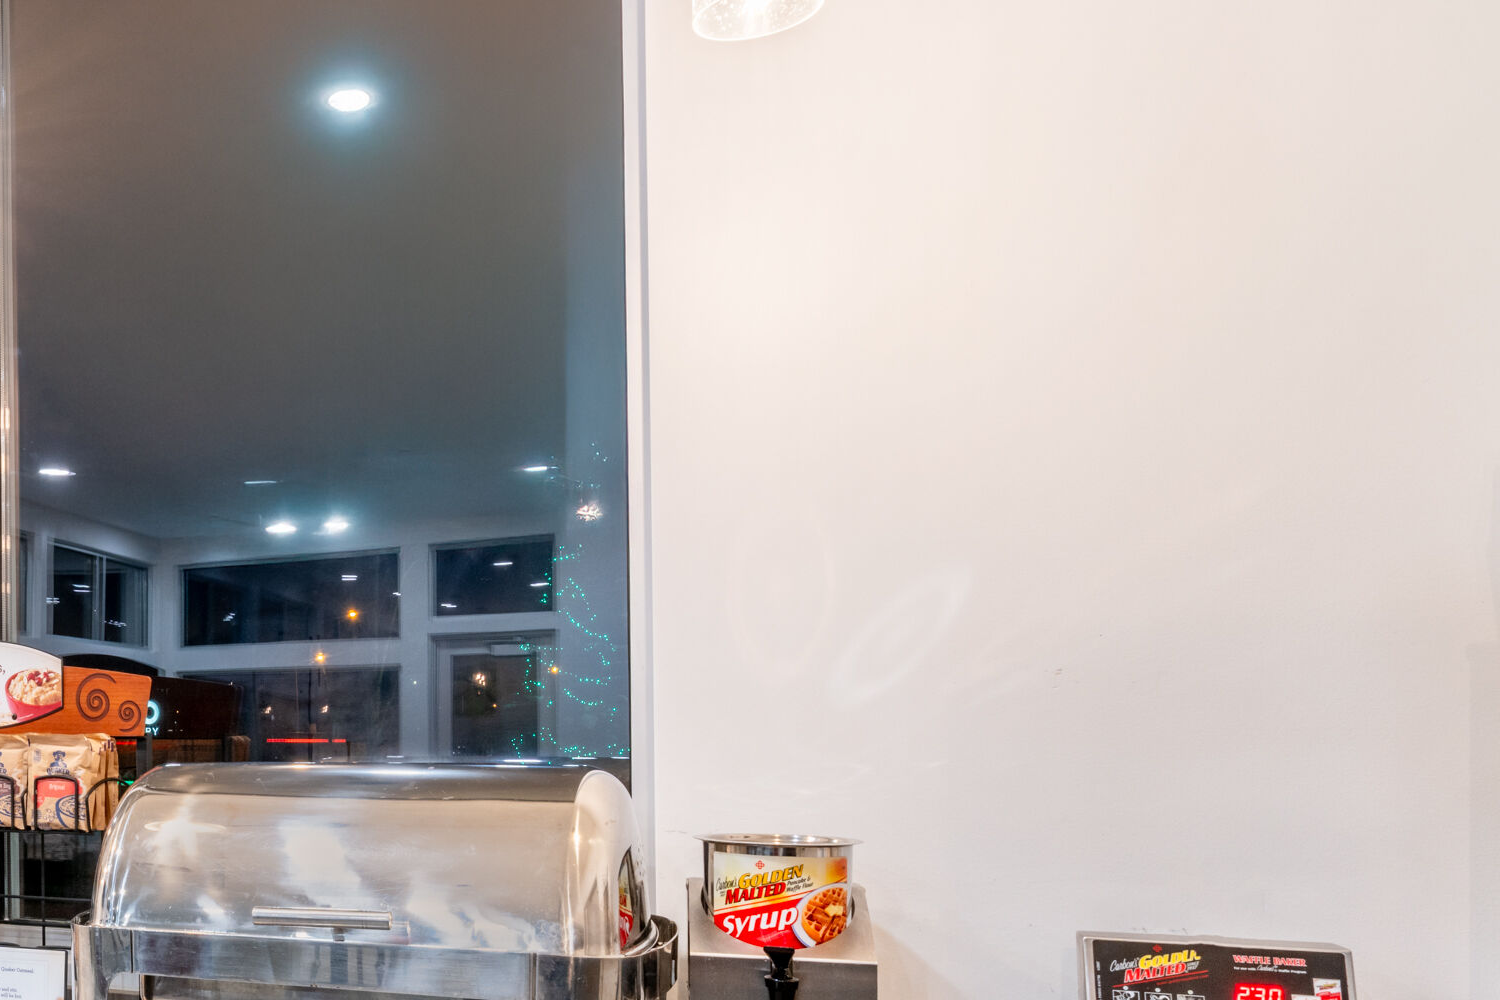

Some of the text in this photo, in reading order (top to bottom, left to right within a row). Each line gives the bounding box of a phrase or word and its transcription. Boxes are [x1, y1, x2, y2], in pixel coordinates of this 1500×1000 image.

[738, 864, 804, 889] GOLDEN
[725, 882, 787, 905] MALTED
[723, 907, 798, 938] Syrup
[1232, 954, 1308, 967] WAFFLE BAKER
[1124, 963, 1187, 983] MALTED
